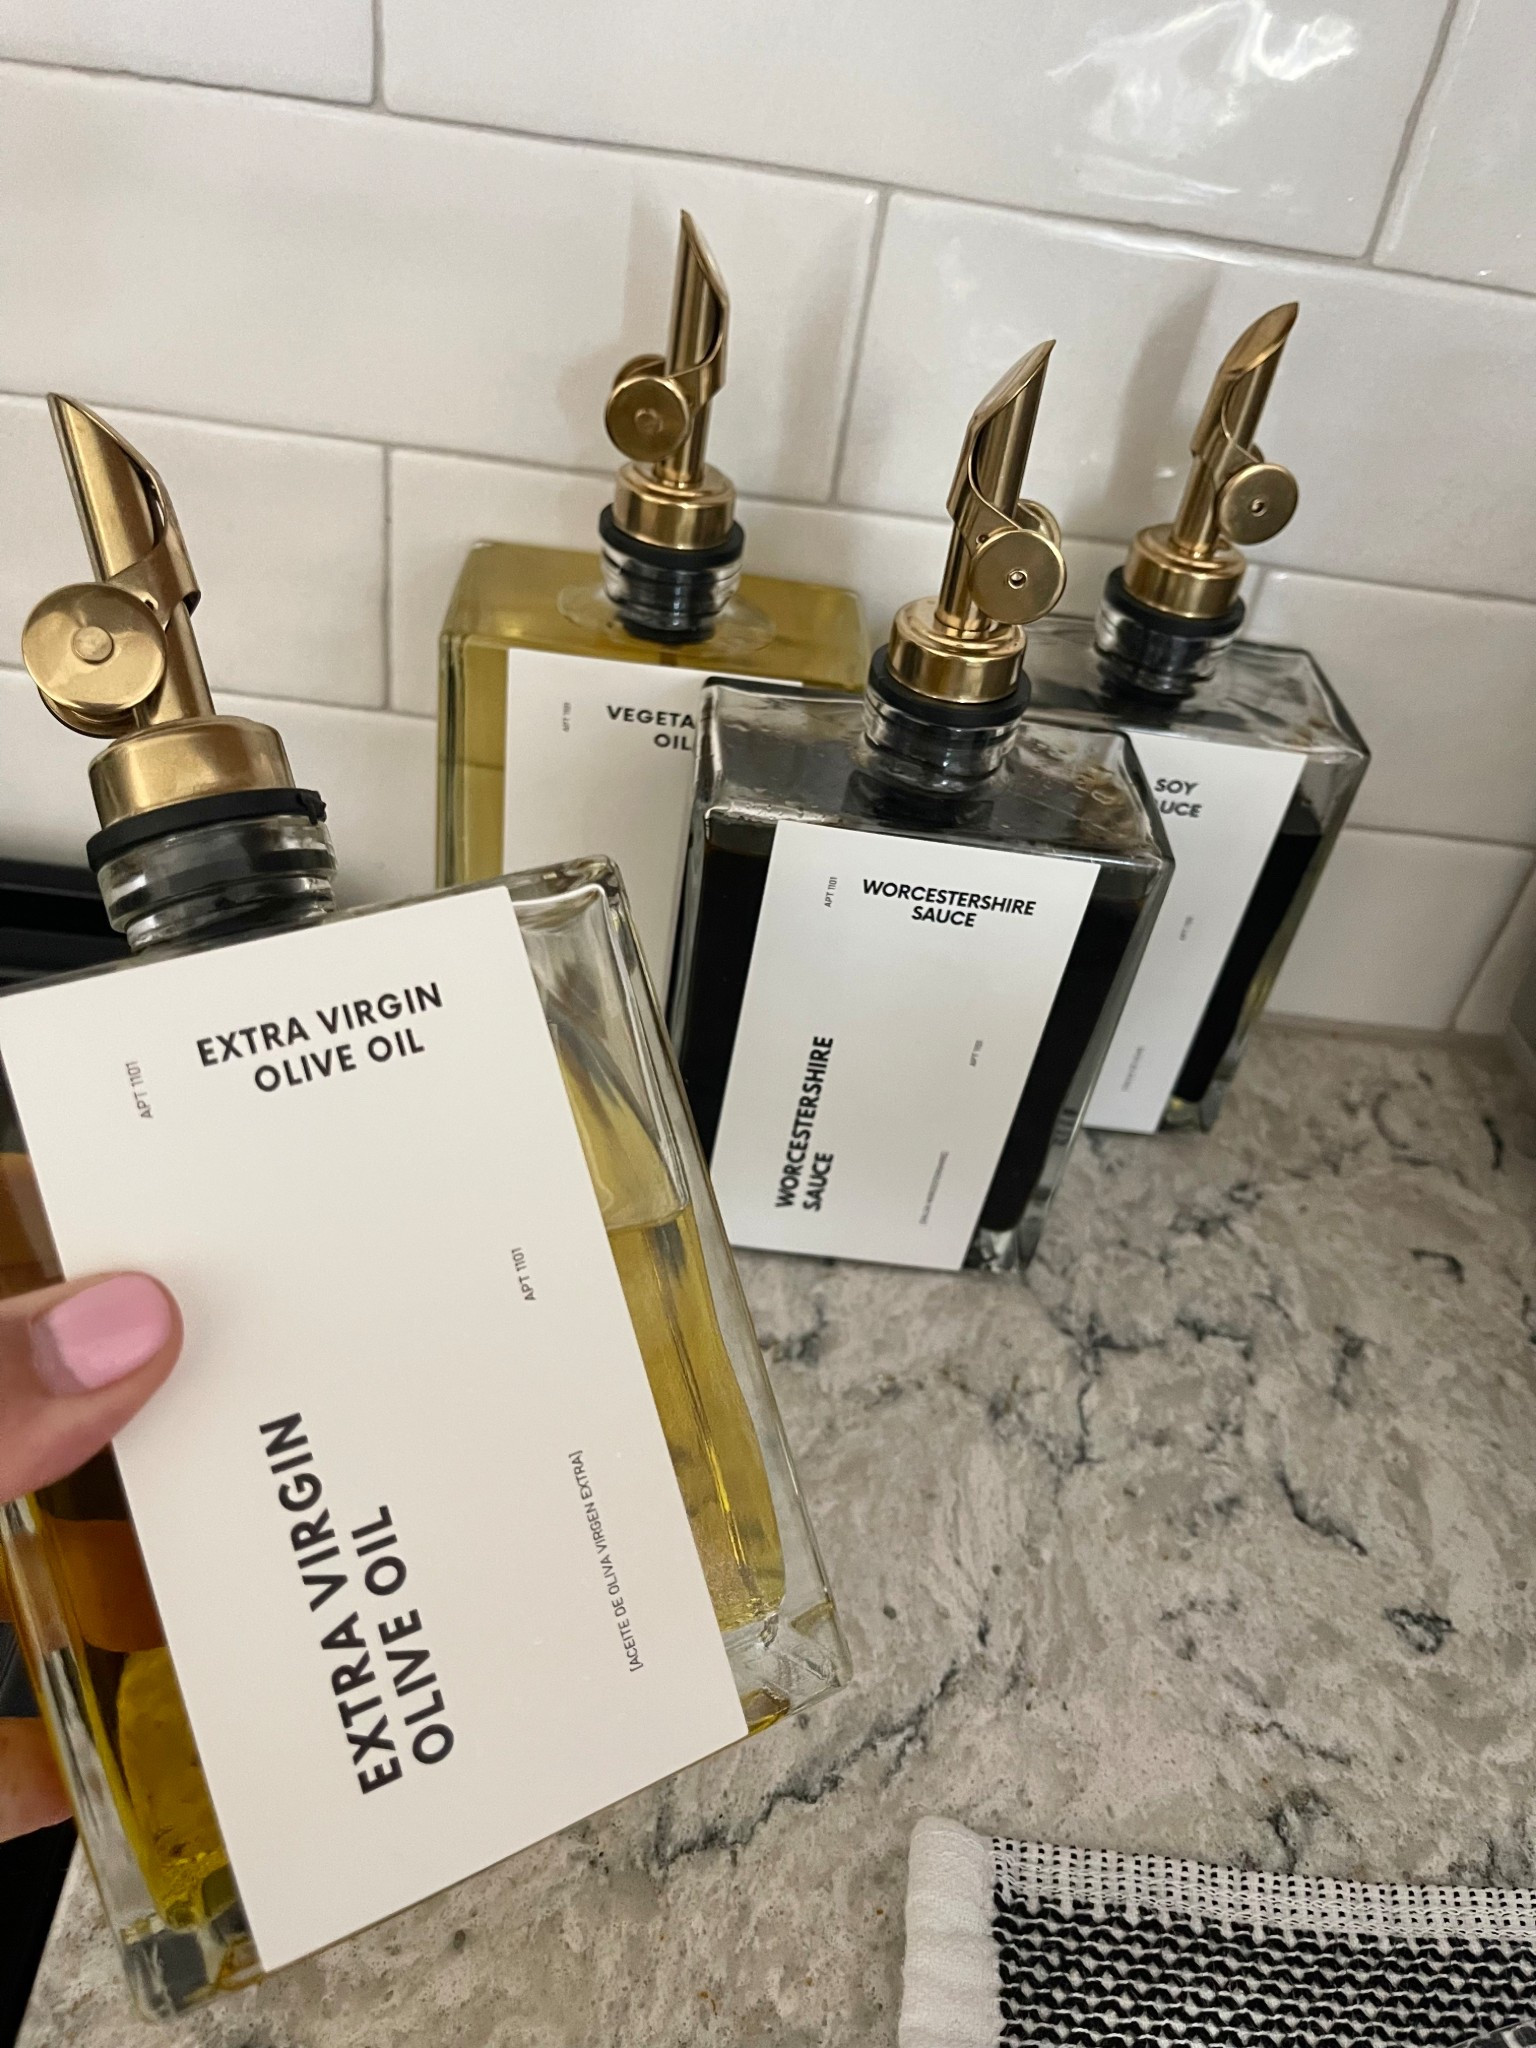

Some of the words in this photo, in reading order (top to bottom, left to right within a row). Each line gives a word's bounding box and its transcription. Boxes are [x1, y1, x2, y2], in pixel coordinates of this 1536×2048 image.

[606, 705, 695, 729] VEGETA
[654, 733, 692, 751] OIL
[1154, 779, 1199, 796] SOY
[1160, 800, 1202, 818] UCE
[827, 876, 838, 890] 1101
[824, 891, 834, 908] APT
[862, 879, 1036, 916] WORCESTERSHIRE
[911, 905, 977, 927] SAUCE
[196, 1017, 311, 1067] EXTRA
[316, 982, 443, 1035] VIRGIN
[126, 1061, 144, 1087] 1101
[254, 1044, 357, 1092] OLIVE
[367, 1028, 426, 1063] OIL
[134, 1091, 153, 1119] APT
[775, 1036, 834, 1208] WORCESTERSHIRE
[802, 1152, 834, 1212] SAUCE
[511, 1246, 527, 1272] 1101
[519, 1275, 536, 1301] APT
[258, 1412, 348, 1612] VIRGIN
[584, 1501, 608, 1554] VIRGEN
[351, 1504, 407, 1596] OIL
[600, 1554, 620, 1595] OLIVA
[611, 1596, 627, 1617] DE
[377, 1608, 455, 1765] OLIVE
[320, 1611, 403, 1795] EXTRA
